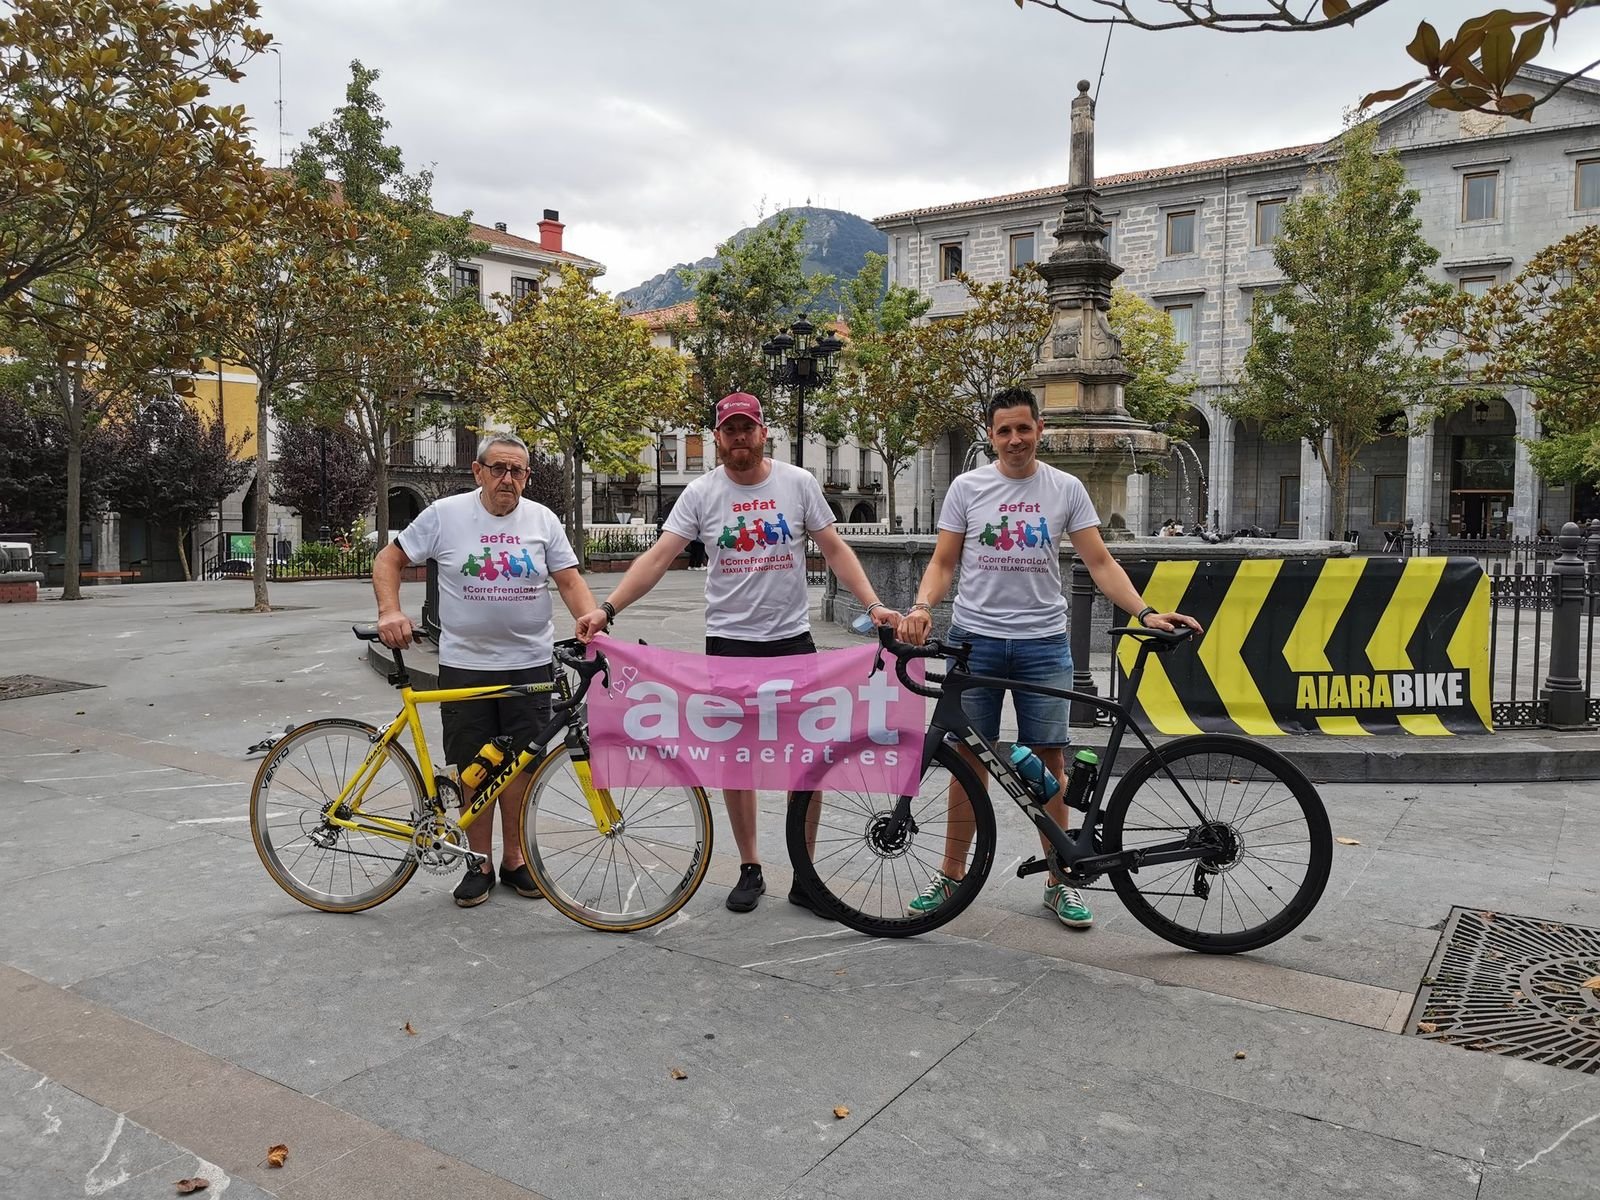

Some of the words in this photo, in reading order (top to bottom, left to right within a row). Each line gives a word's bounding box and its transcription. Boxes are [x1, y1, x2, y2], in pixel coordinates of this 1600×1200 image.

[732, 499, 777, 513] aefat
[998, 502, 1041, 513] aefat
[480, 532, 521, 545] aefat
[622, 671, 900, 746] aefat
[1296, 672, 1463, 710] AIARABIKE
[261, 746, 290, 789] VENTO
[366, 737, 386, 765] GIANT
[626, 743, 899, 767] www.aefat.es
[471, 757, 521, 815] GIANT
[964, 726, 1046, 822] TREK
[680, 840, 702, 891] VENTO
